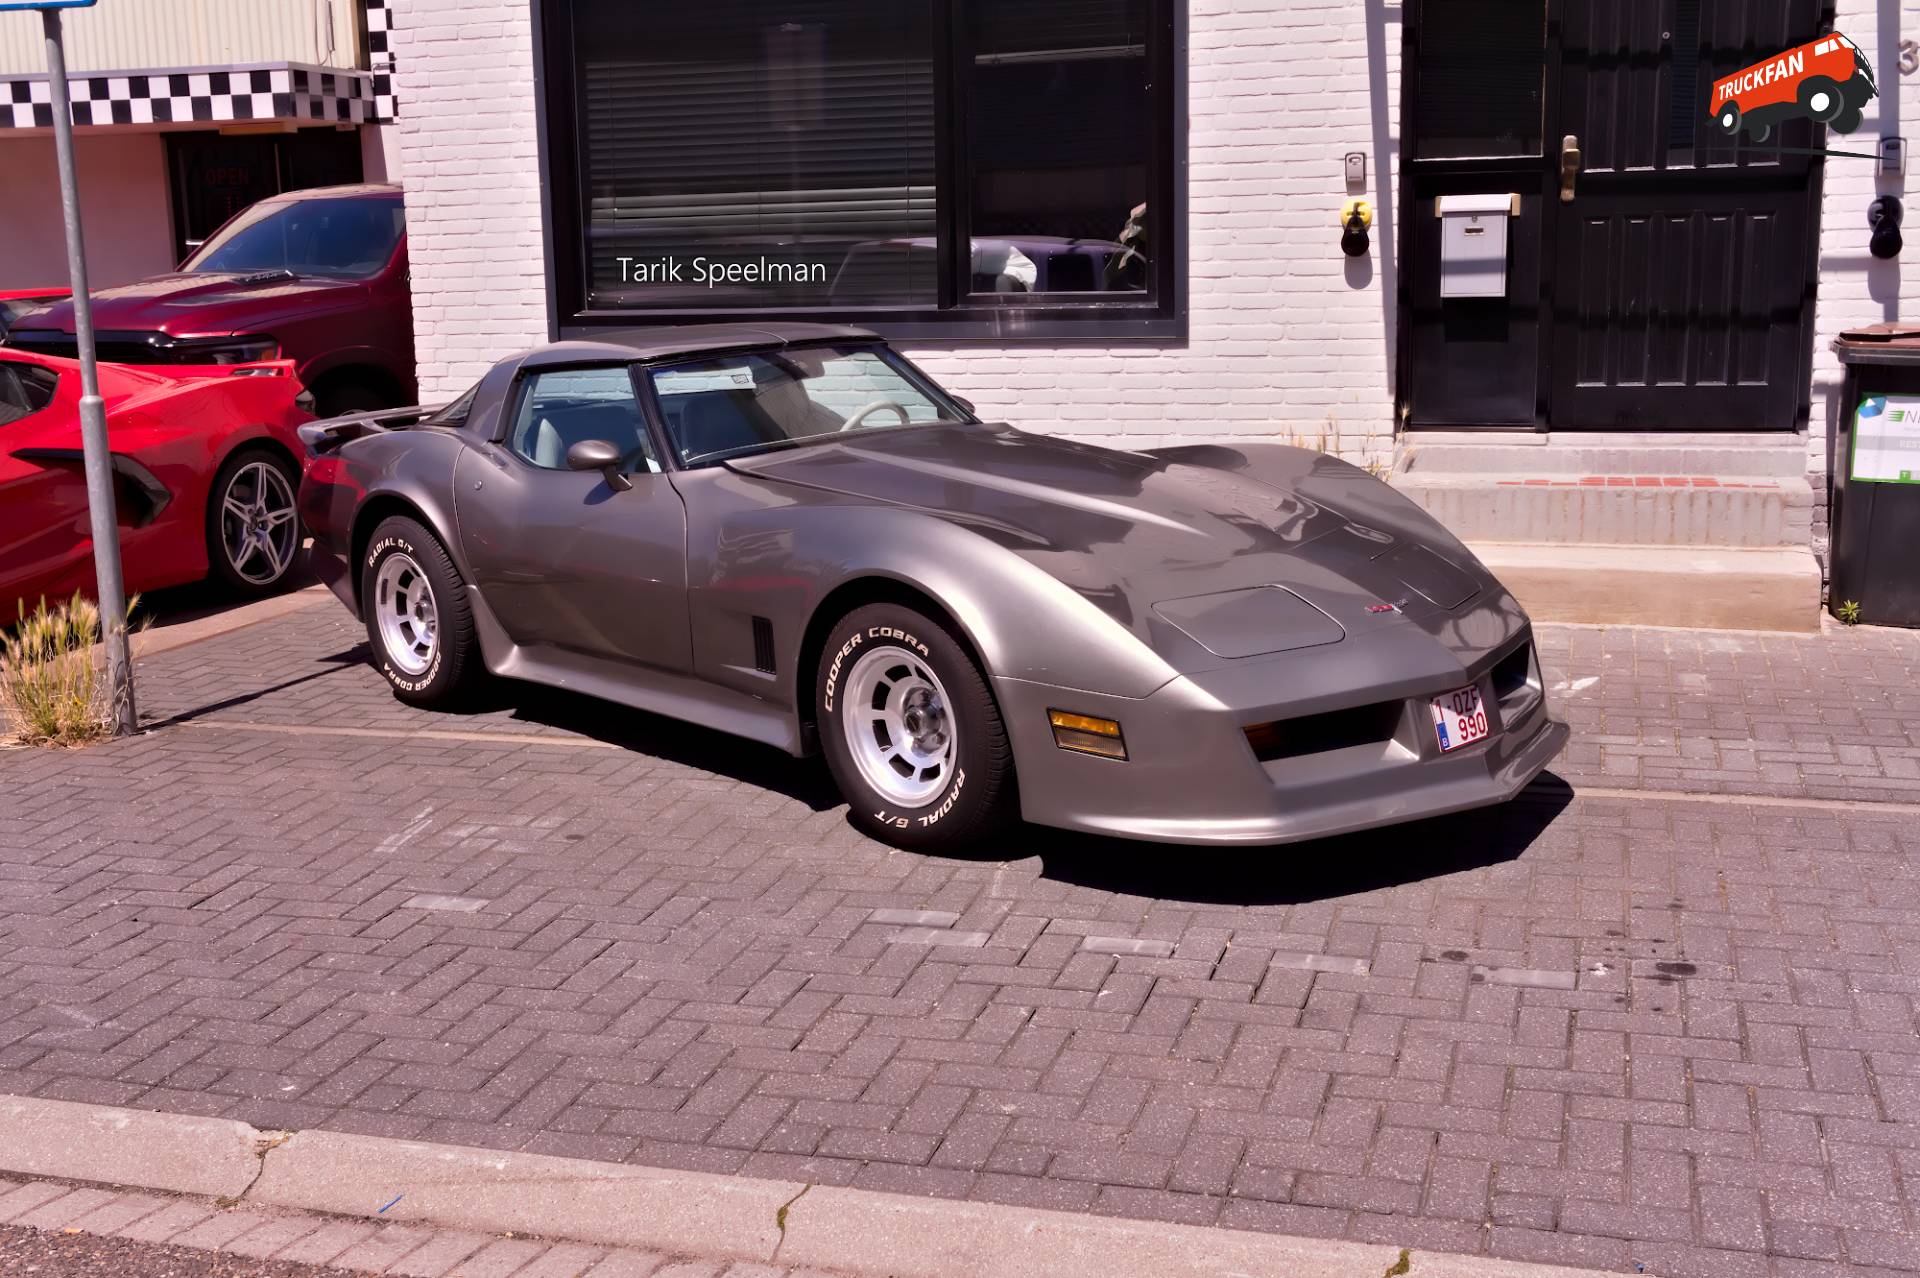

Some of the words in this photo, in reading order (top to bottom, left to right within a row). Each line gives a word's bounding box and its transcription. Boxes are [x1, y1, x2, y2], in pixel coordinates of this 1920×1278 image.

[368, 537, 396, 568] RADIAL
[383, 662, 414, 691] COBRA
[415, 652, 442, 692] COOPER
[825, 632, 863, 712] COOPER
[868, 627, 929, 657] COBRA
[1458, 712, 1486, 740] 990
[918, 768, 966, 828] RADIAL
[874, 810, 909, 828] G/T
